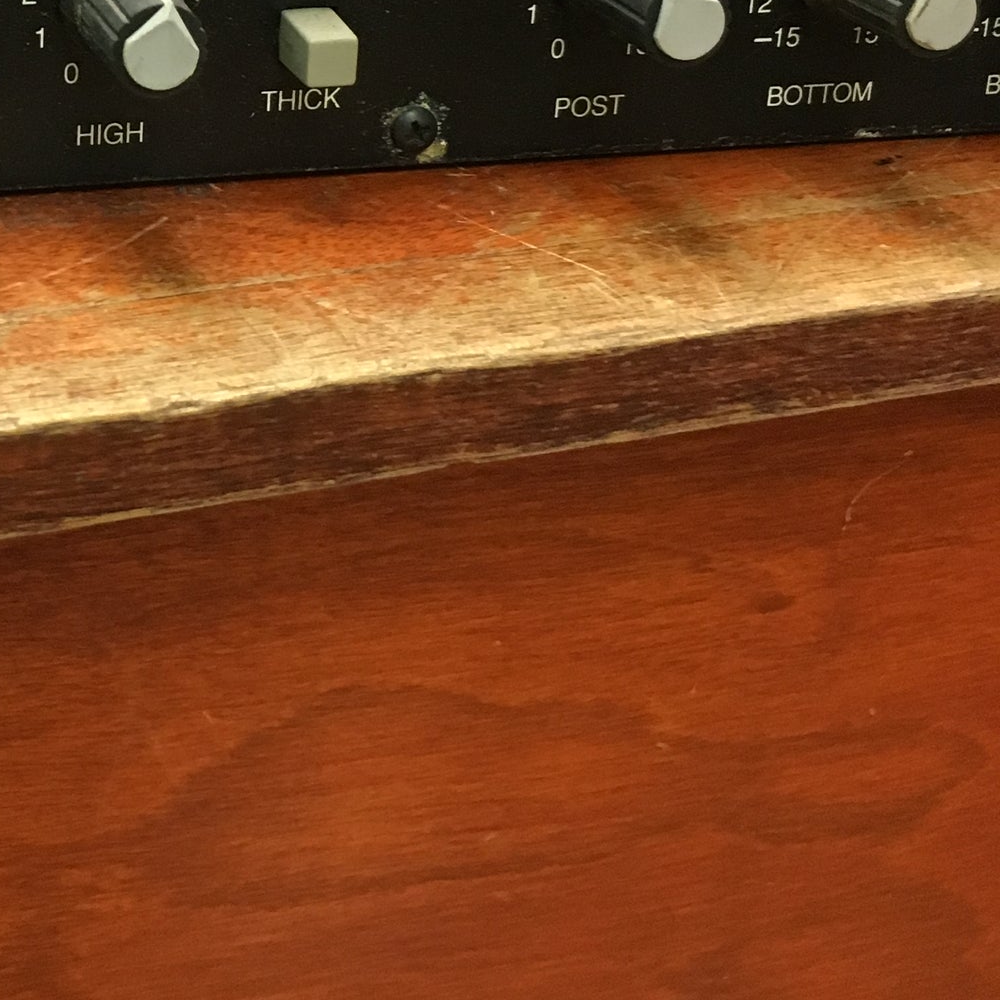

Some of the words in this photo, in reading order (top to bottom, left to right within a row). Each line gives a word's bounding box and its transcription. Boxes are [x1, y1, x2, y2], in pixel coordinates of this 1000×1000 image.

[527, 4, 537, 25] 1
[35, 27, 45, 49] 1
[550, 38, 565, 59] 0
[63, 62, 79, 85] 0
[260, 87, 341, 112] THICK
[766, 81, 873, 107] BOTTOM
[554, 94, 626, 119] POST
[76, 121, 144, 147] HIGH
